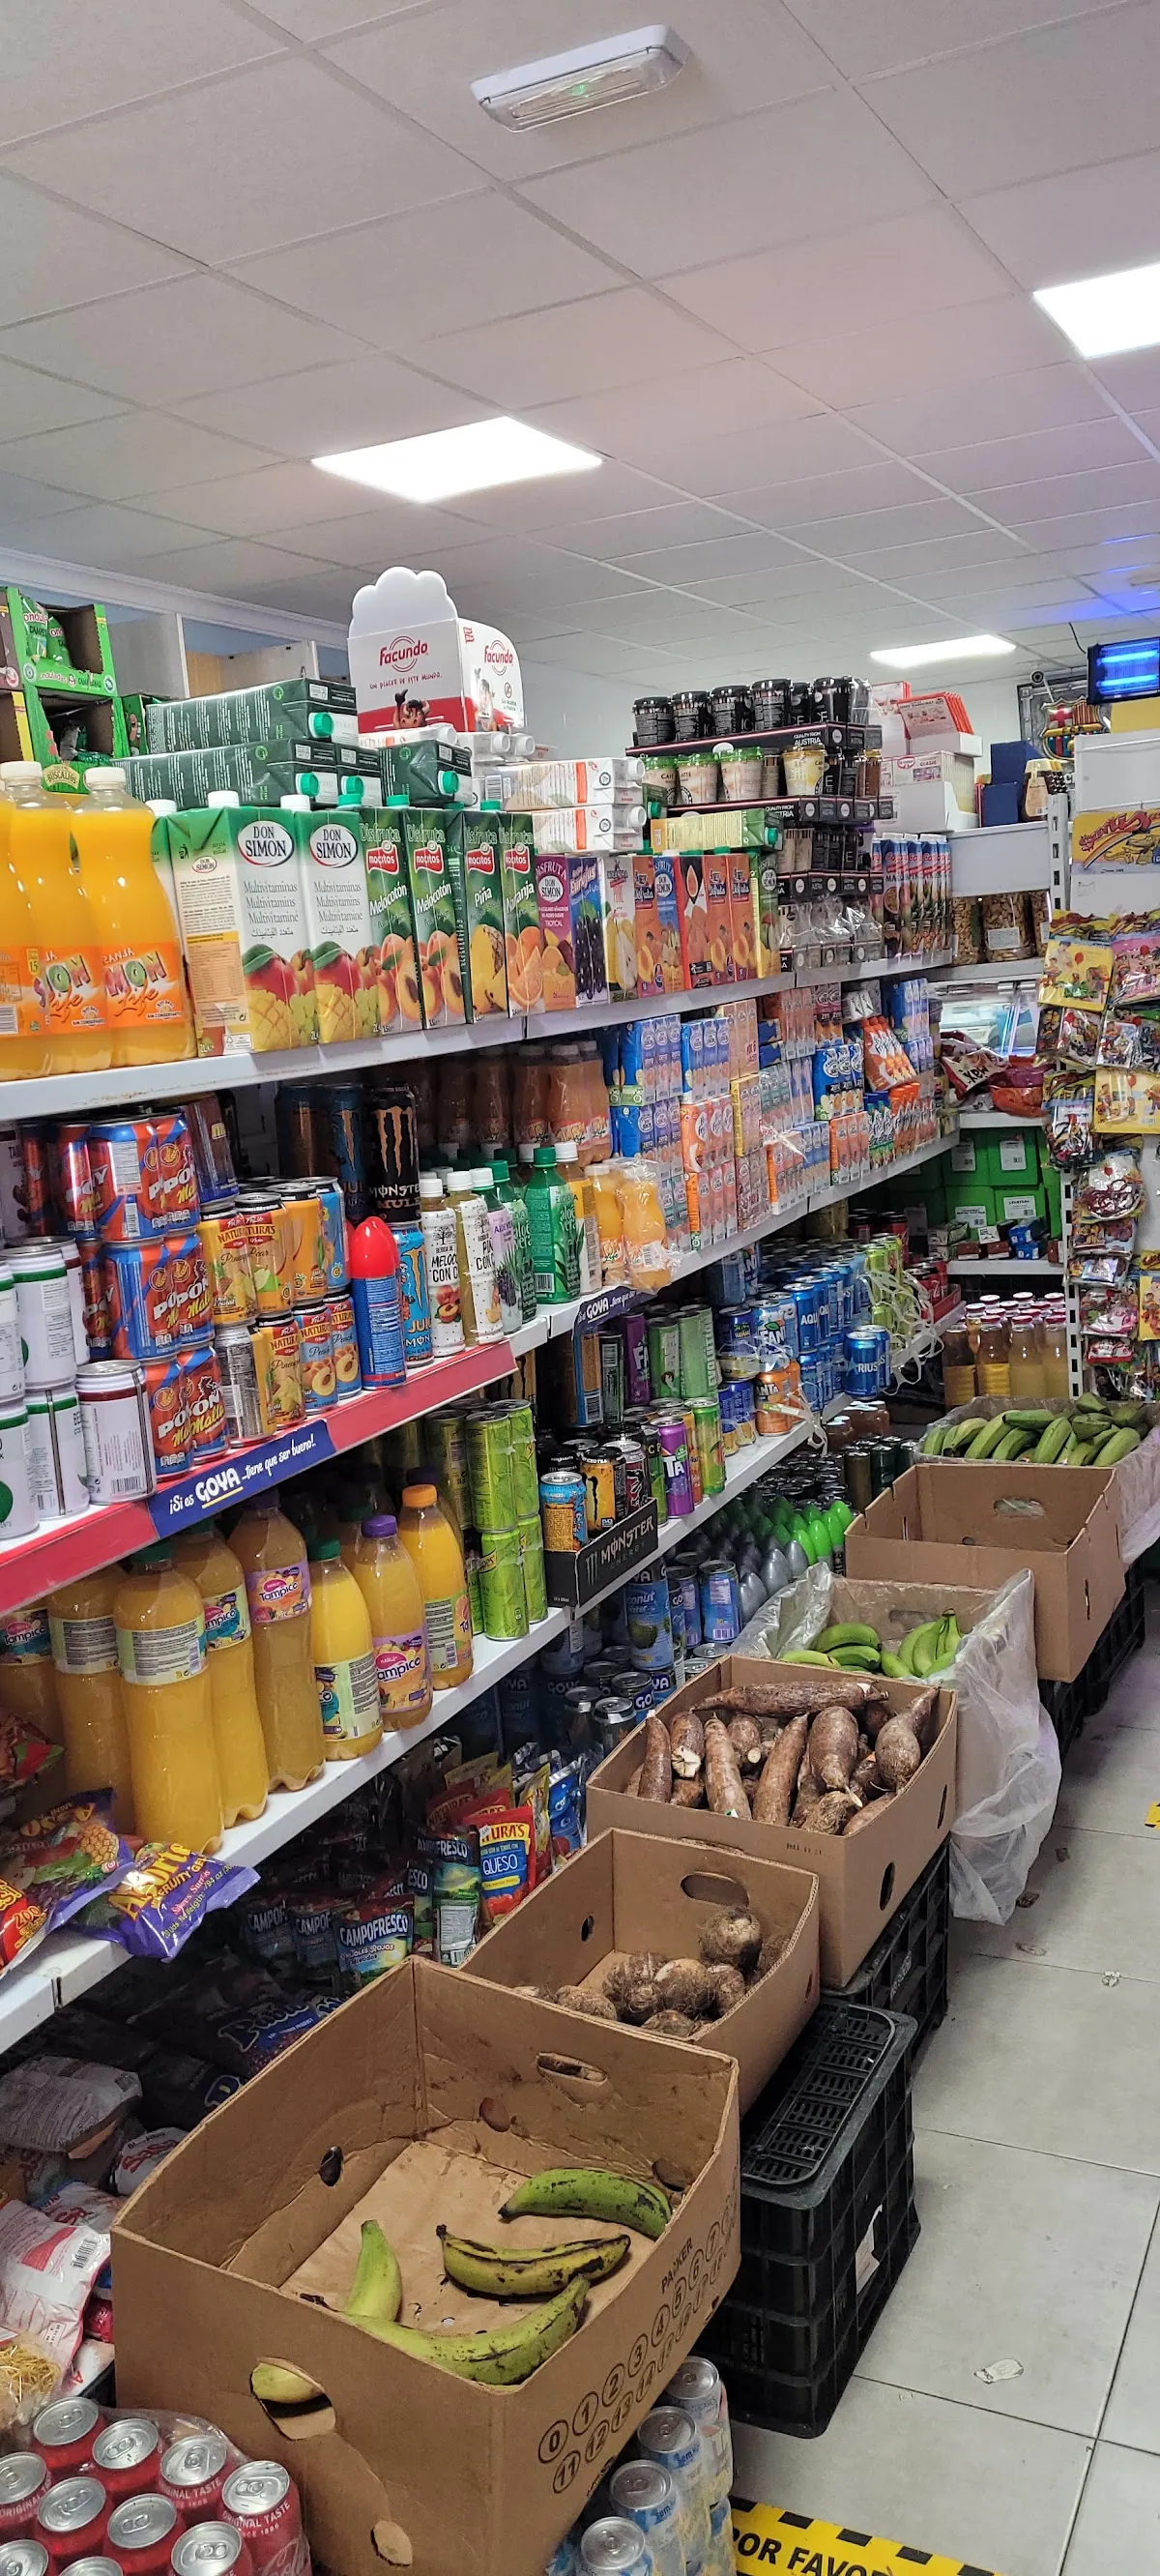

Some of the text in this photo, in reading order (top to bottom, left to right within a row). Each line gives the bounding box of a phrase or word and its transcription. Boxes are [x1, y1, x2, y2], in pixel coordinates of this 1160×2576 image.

[794, 738, 821, 746] AUSTRIA
[253, 825, 275, 839] DON
[323, 829, 341, 842] DON
[245, 840, 287, 858] SIMON
[316, 842, 352, 859] SIMON
[244, 881, 298, 894] Multivitaminas
[313, 881, 362, 893] Multivitaminas
[417, 881, 452, 915] Melocotón
[474, 886, 493, 908] Piña
[506, 881, 535, 915] Naranja
[541, 888, 561, 897] SIMON
[246, 896, 296, 910] Multivitamins
[315, 895, 361, 908] Multivitamins
[369, 883, 408, 917] Melocotón
[432, 1268, 451, 1283] CON
[586, 1297, 609, 1319] GOYA
[184, 1495, 194, 1509] es
[194, 1467, 241, 1503] GOYA
[264, 1454, 278, 1477] que
[278, 1448, 290, 1464] ser
[259, 1582, 299, 1602] Tampico
[205, 1609, 236, 1632] ampico
[376, 1656, 421, 1682] ampico
[483, 1853, 518, 1876] QUESO
[14, 1905, 42, 1928] 200
[295, 1912, 334, 1936] CAMPOF
[340, 1914, 408, 1947] CAMPOFRESCO
[192, 2477, 222, 2499] TASTE
[263, 2500, 291, 2525] TASTE
